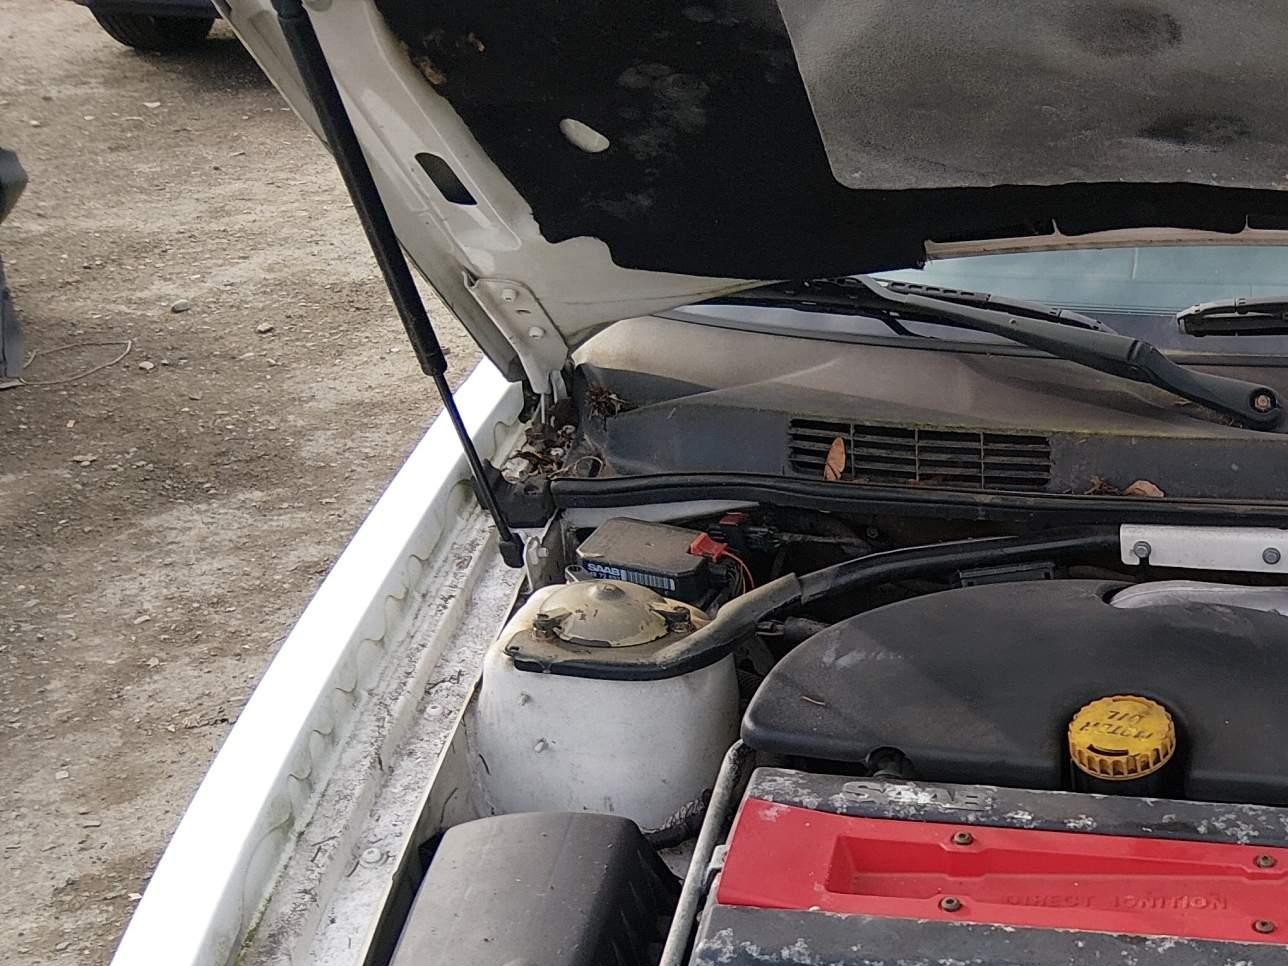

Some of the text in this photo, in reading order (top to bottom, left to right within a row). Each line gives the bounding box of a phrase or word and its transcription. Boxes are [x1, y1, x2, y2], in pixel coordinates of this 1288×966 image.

[588, 563, 620, 574] SAAB
[841, 781, 995, 811] SAAB
[1111, 894, 1229, 911] IGNITION
